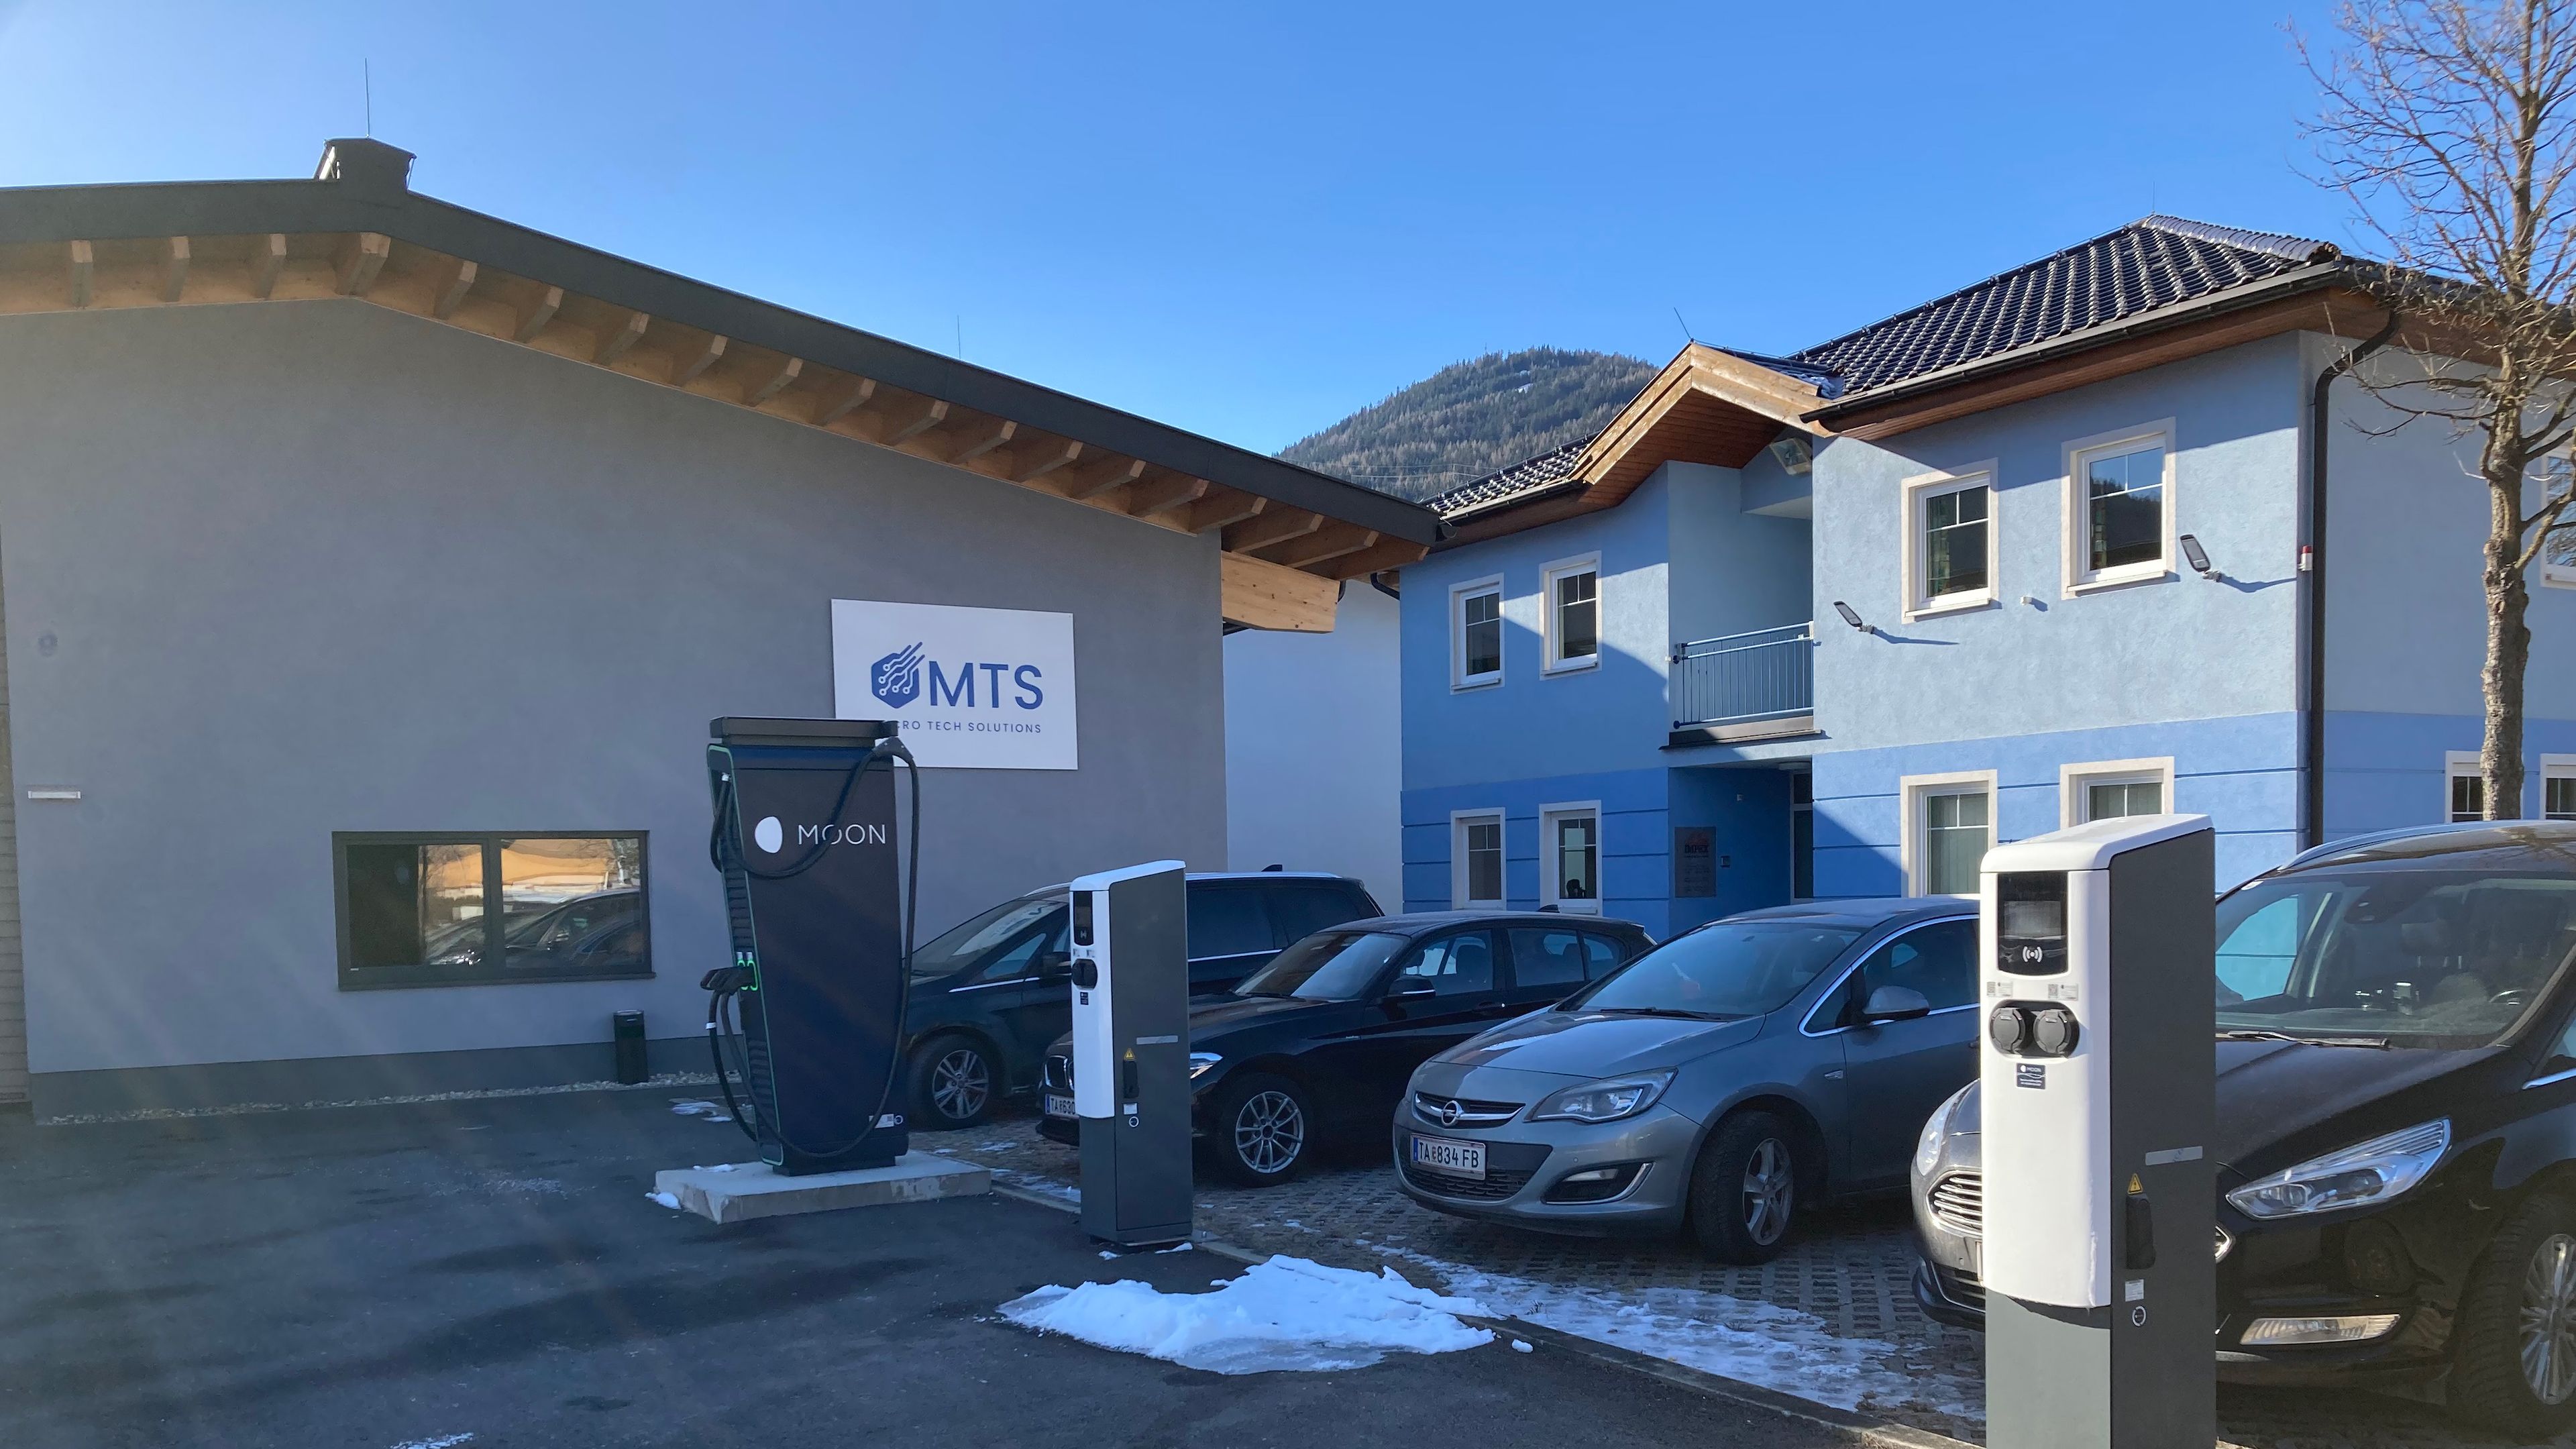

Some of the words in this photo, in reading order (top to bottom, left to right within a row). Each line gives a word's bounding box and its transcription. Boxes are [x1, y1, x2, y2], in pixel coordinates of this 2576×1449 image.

[928, 661, 1044, 710] MTS
[927, 720, 962, 731] TECH
[968, 722, 1042, 733] SOLUTIONS
[798, 824, 886, 845] MOON
[1437, 1146, 1459, 1166] 834
[1462, 1148, 1479, 1168] FB
